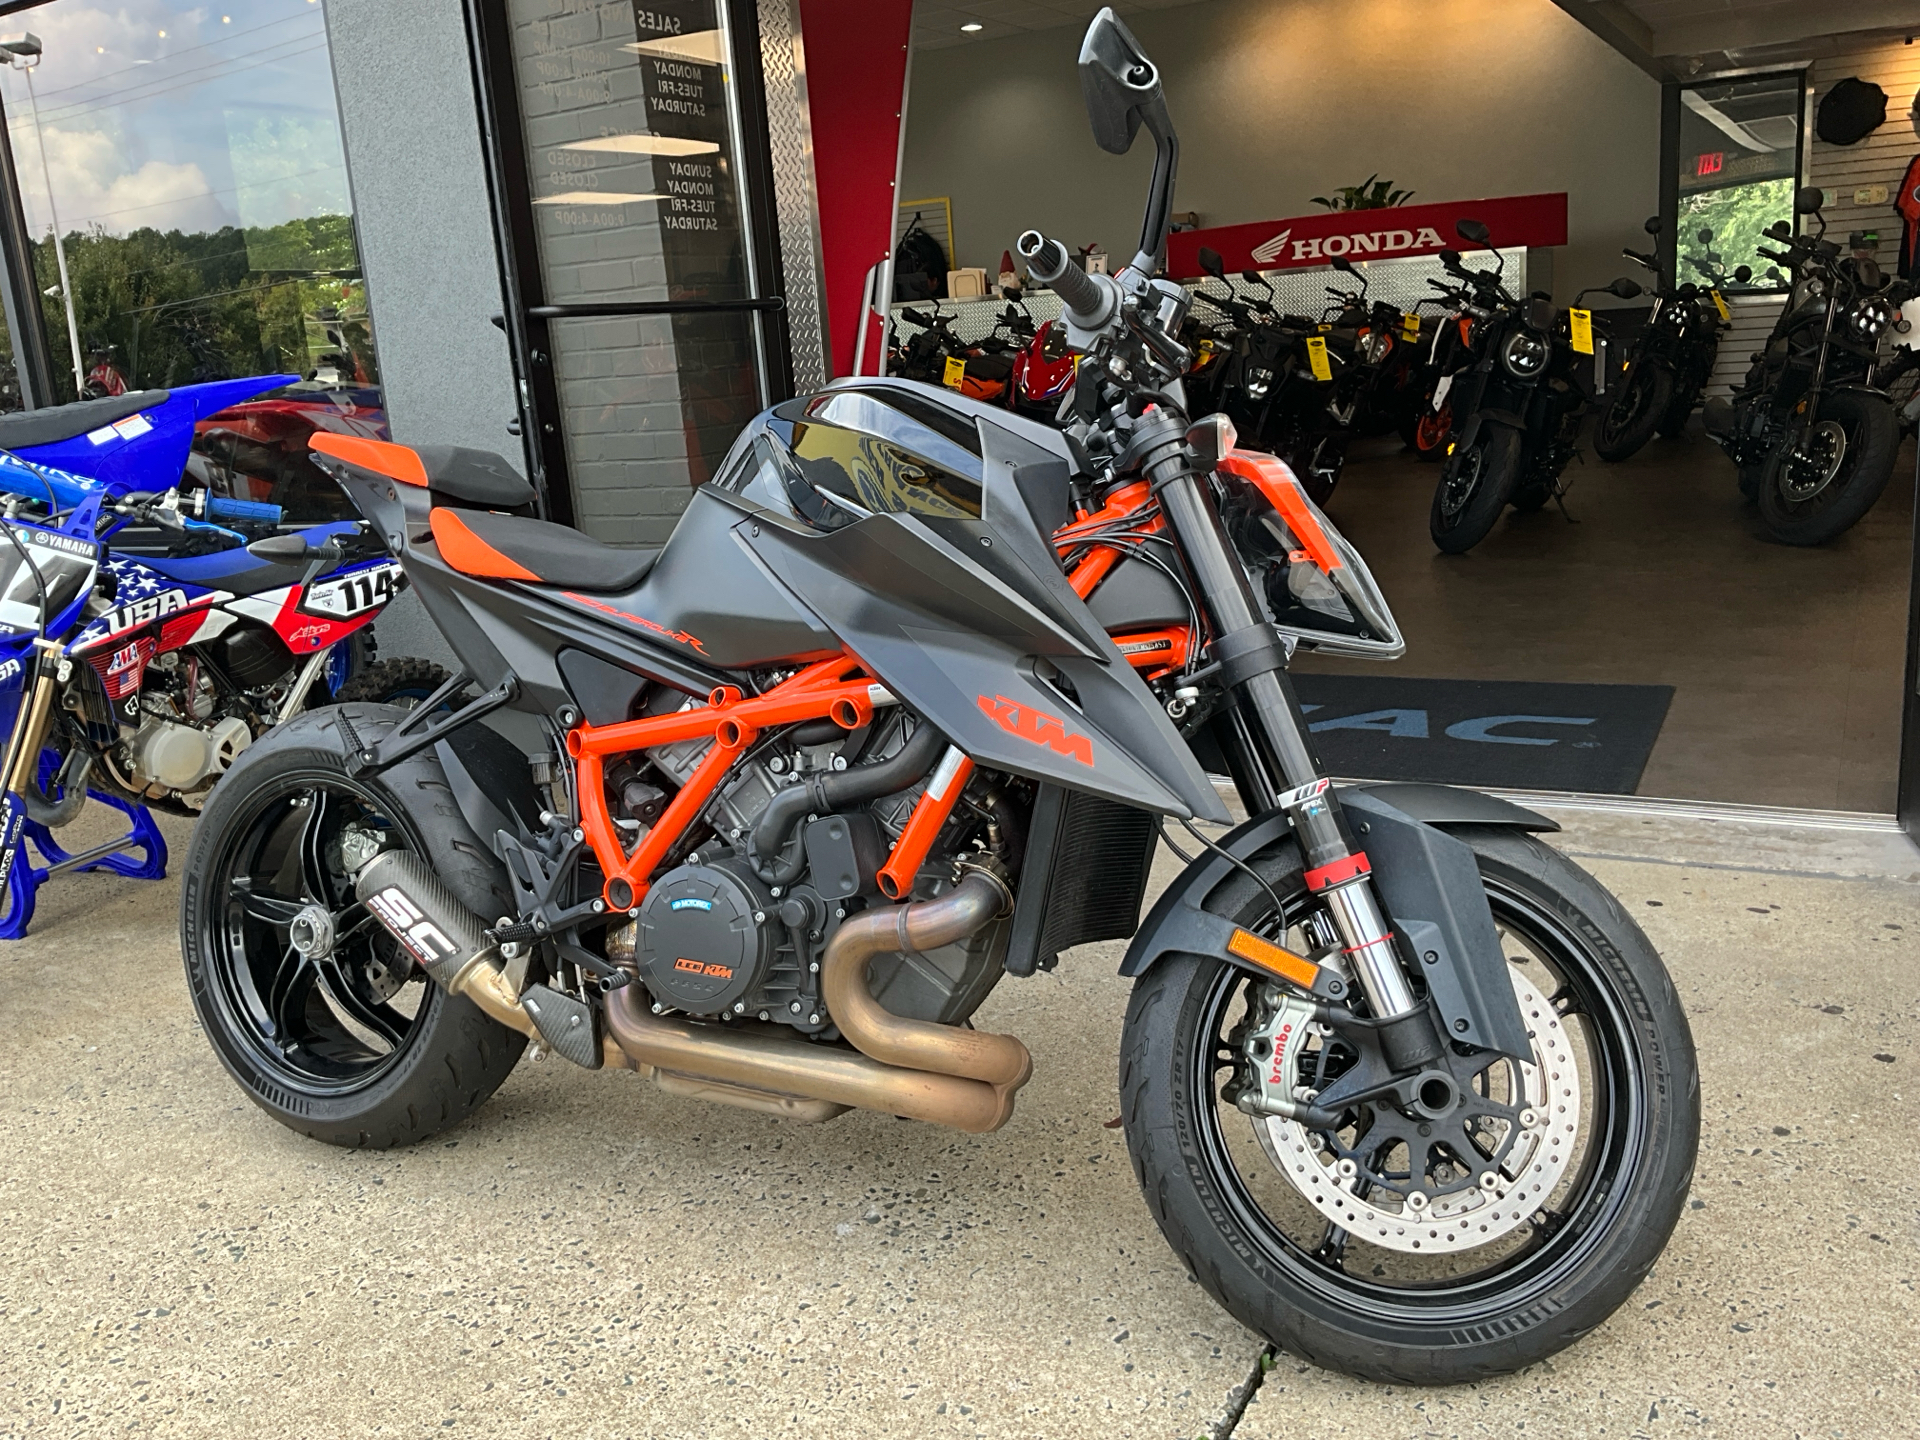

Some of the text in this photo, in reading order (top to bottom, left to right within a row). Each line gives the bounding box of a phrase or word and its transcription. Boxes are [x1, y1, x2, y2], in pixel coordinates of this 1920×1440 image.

[1291, 227, 1446, 261] HONDA
[49, 535, 94, 557] YAMAHA
[104, 588, 190, 635] USA
[338, 569, 395, 612] 114
[110, 643, 140, 671] AMA
[977, 693, 1095, 768] KTM
[1301, 703, 1597, 746] AC
[186, 883, 198, 964] MICHELIN
[372, 888, 456, 960] SC
[682, 899, 710, 909] MOTOREX
[704, 964, 733, 979] KTM
[1581, 923, 1649, 1016] MICHELIN
[1644, 1028, 1666, 1096] POWER
[1175, 1041, 1184, 1057] 17
[1268, 1023, 1292, 1085] brembo
[1173, 1065, 1183, 1087] ZR
[1174, 1089, 1191, 1148] 120/70
[1188, 1162, 1252, 1260] MICHELIN
